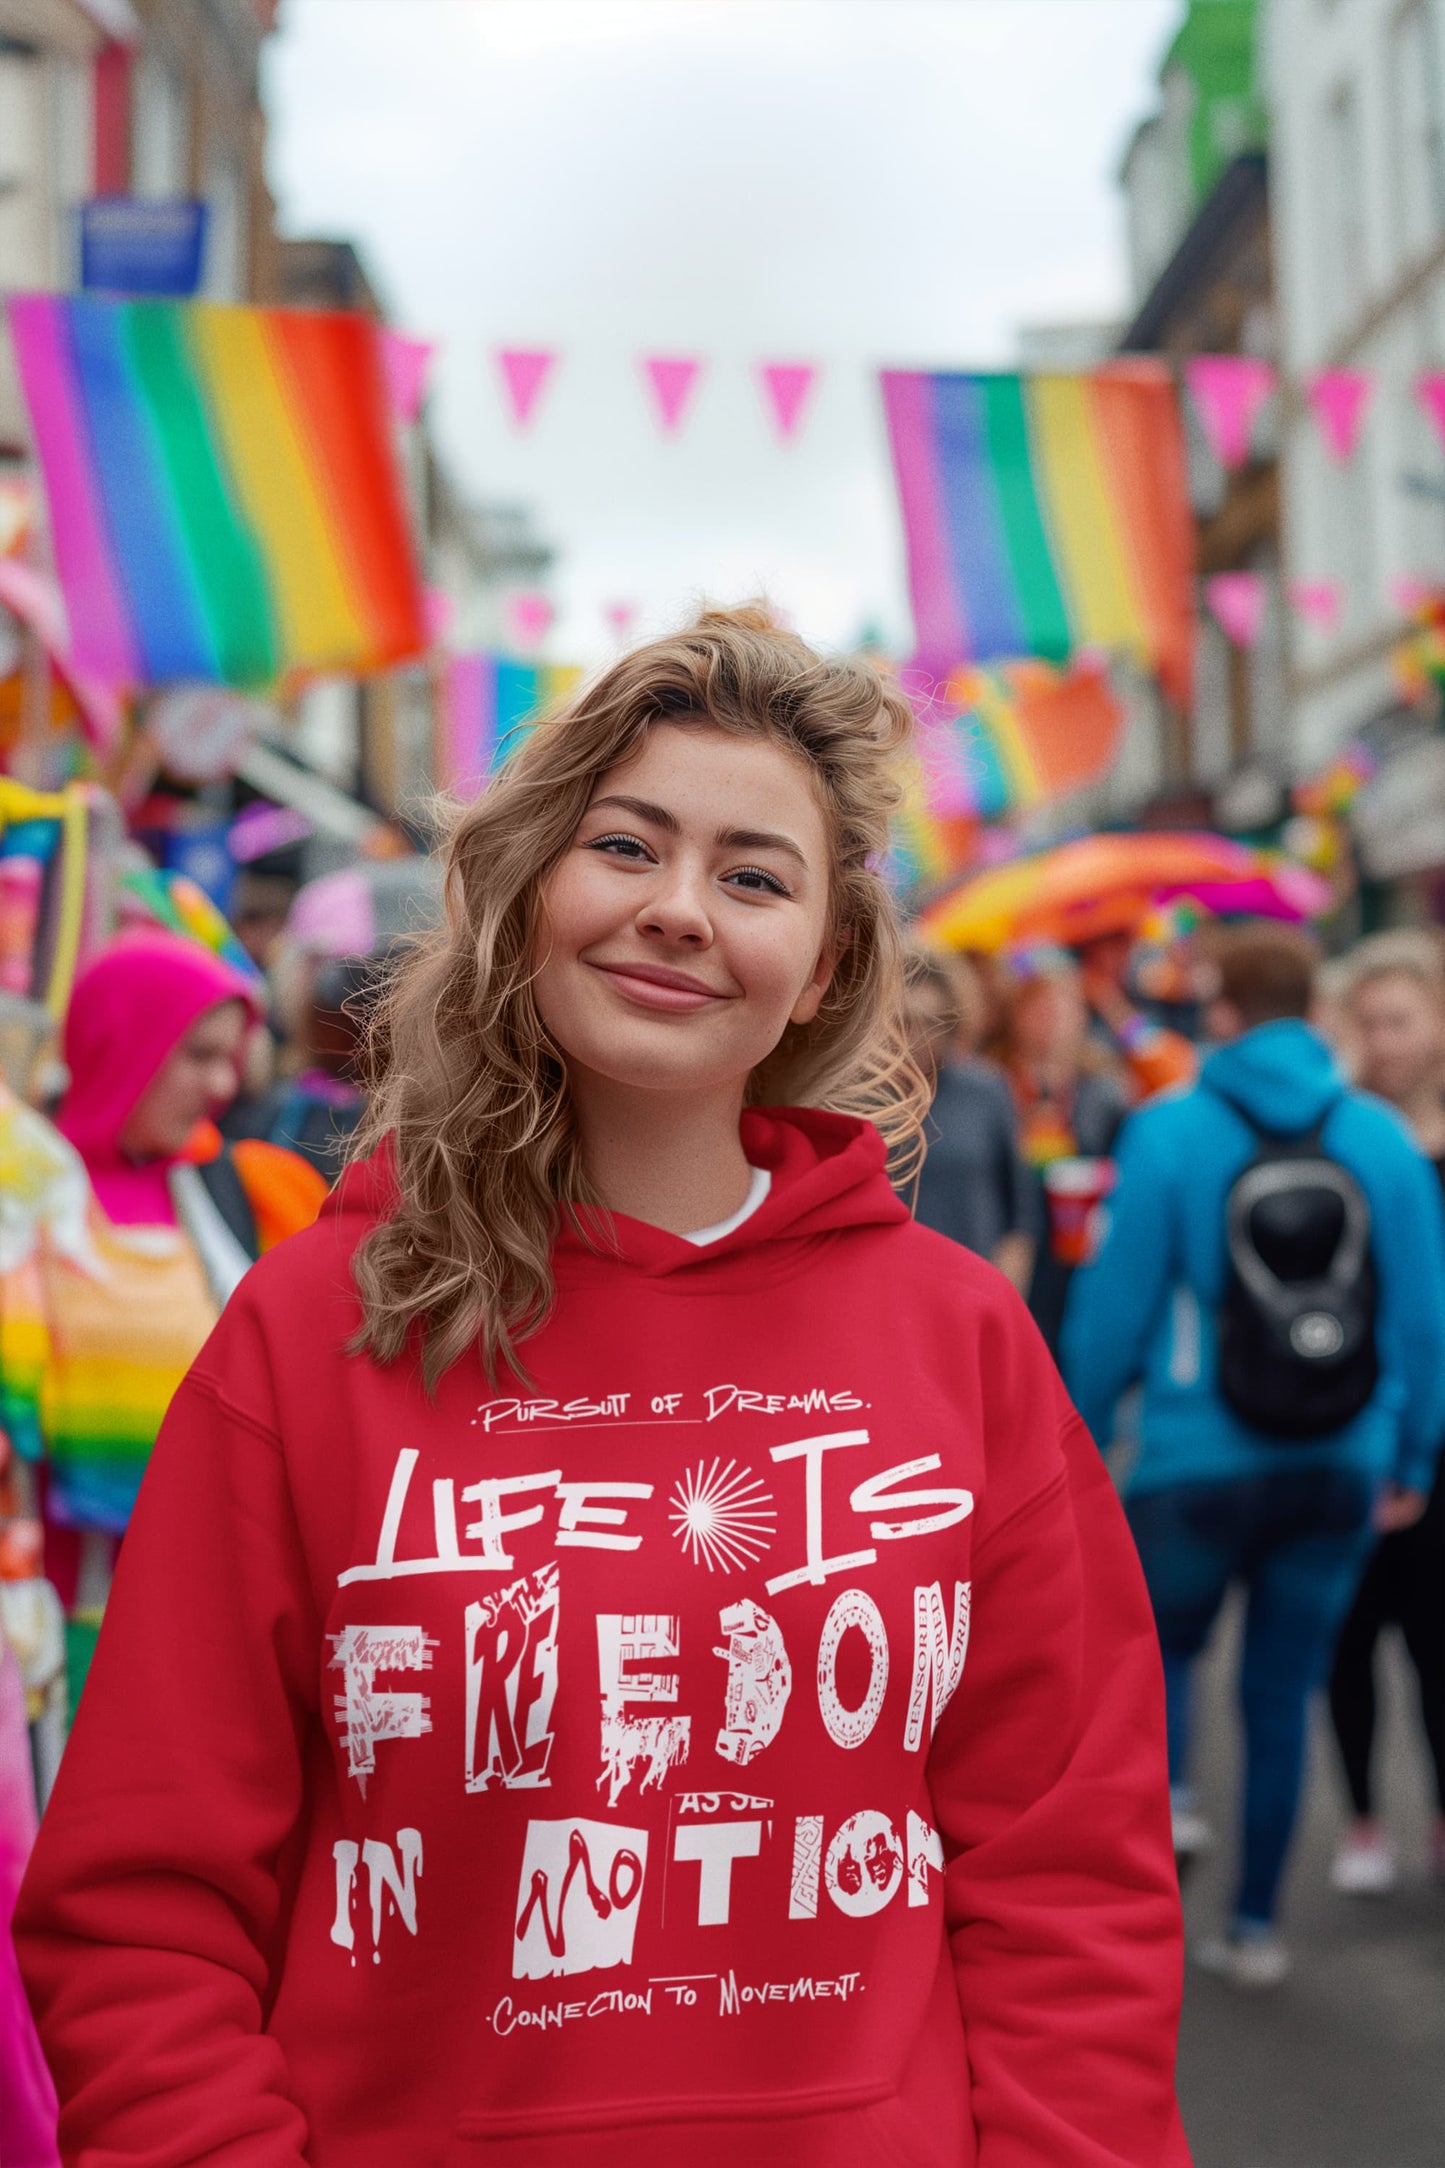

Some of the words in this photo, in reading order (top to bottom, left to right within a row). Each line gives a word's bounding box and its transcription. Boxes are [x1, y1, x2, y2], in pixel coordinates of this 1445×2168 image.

[650, 1393, 684, 1416] OF
[338, 1447, 655, 1588] LIFE
[765, 1428, 975, 1597] IS
[907, 1593, 928, 1745] CENSORED
[330, 1827, 423, 1966] IN
[665, 1984, 698, 2006] TO
